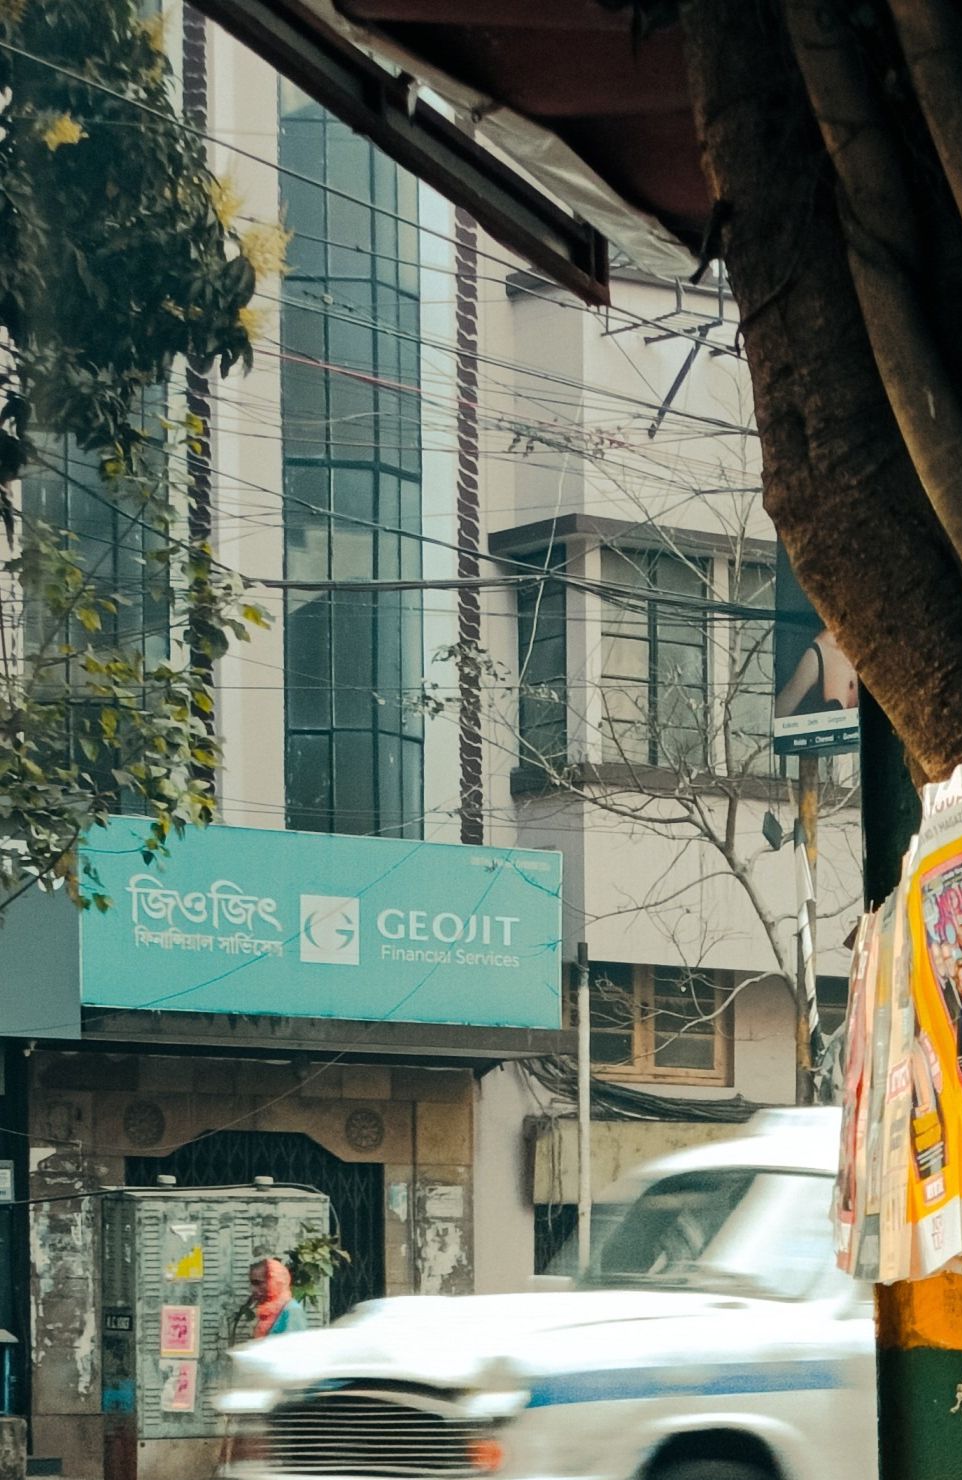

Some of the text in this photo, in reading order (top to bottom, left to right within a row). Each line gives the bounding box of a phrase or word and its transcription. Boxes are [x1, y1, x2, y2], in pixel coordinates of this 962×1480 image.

[125, 873, 283, 932] জিওজিৎ
[377, 908, 520, 946] GEOJIT
[381, 944, 520, 968] Financial Services
